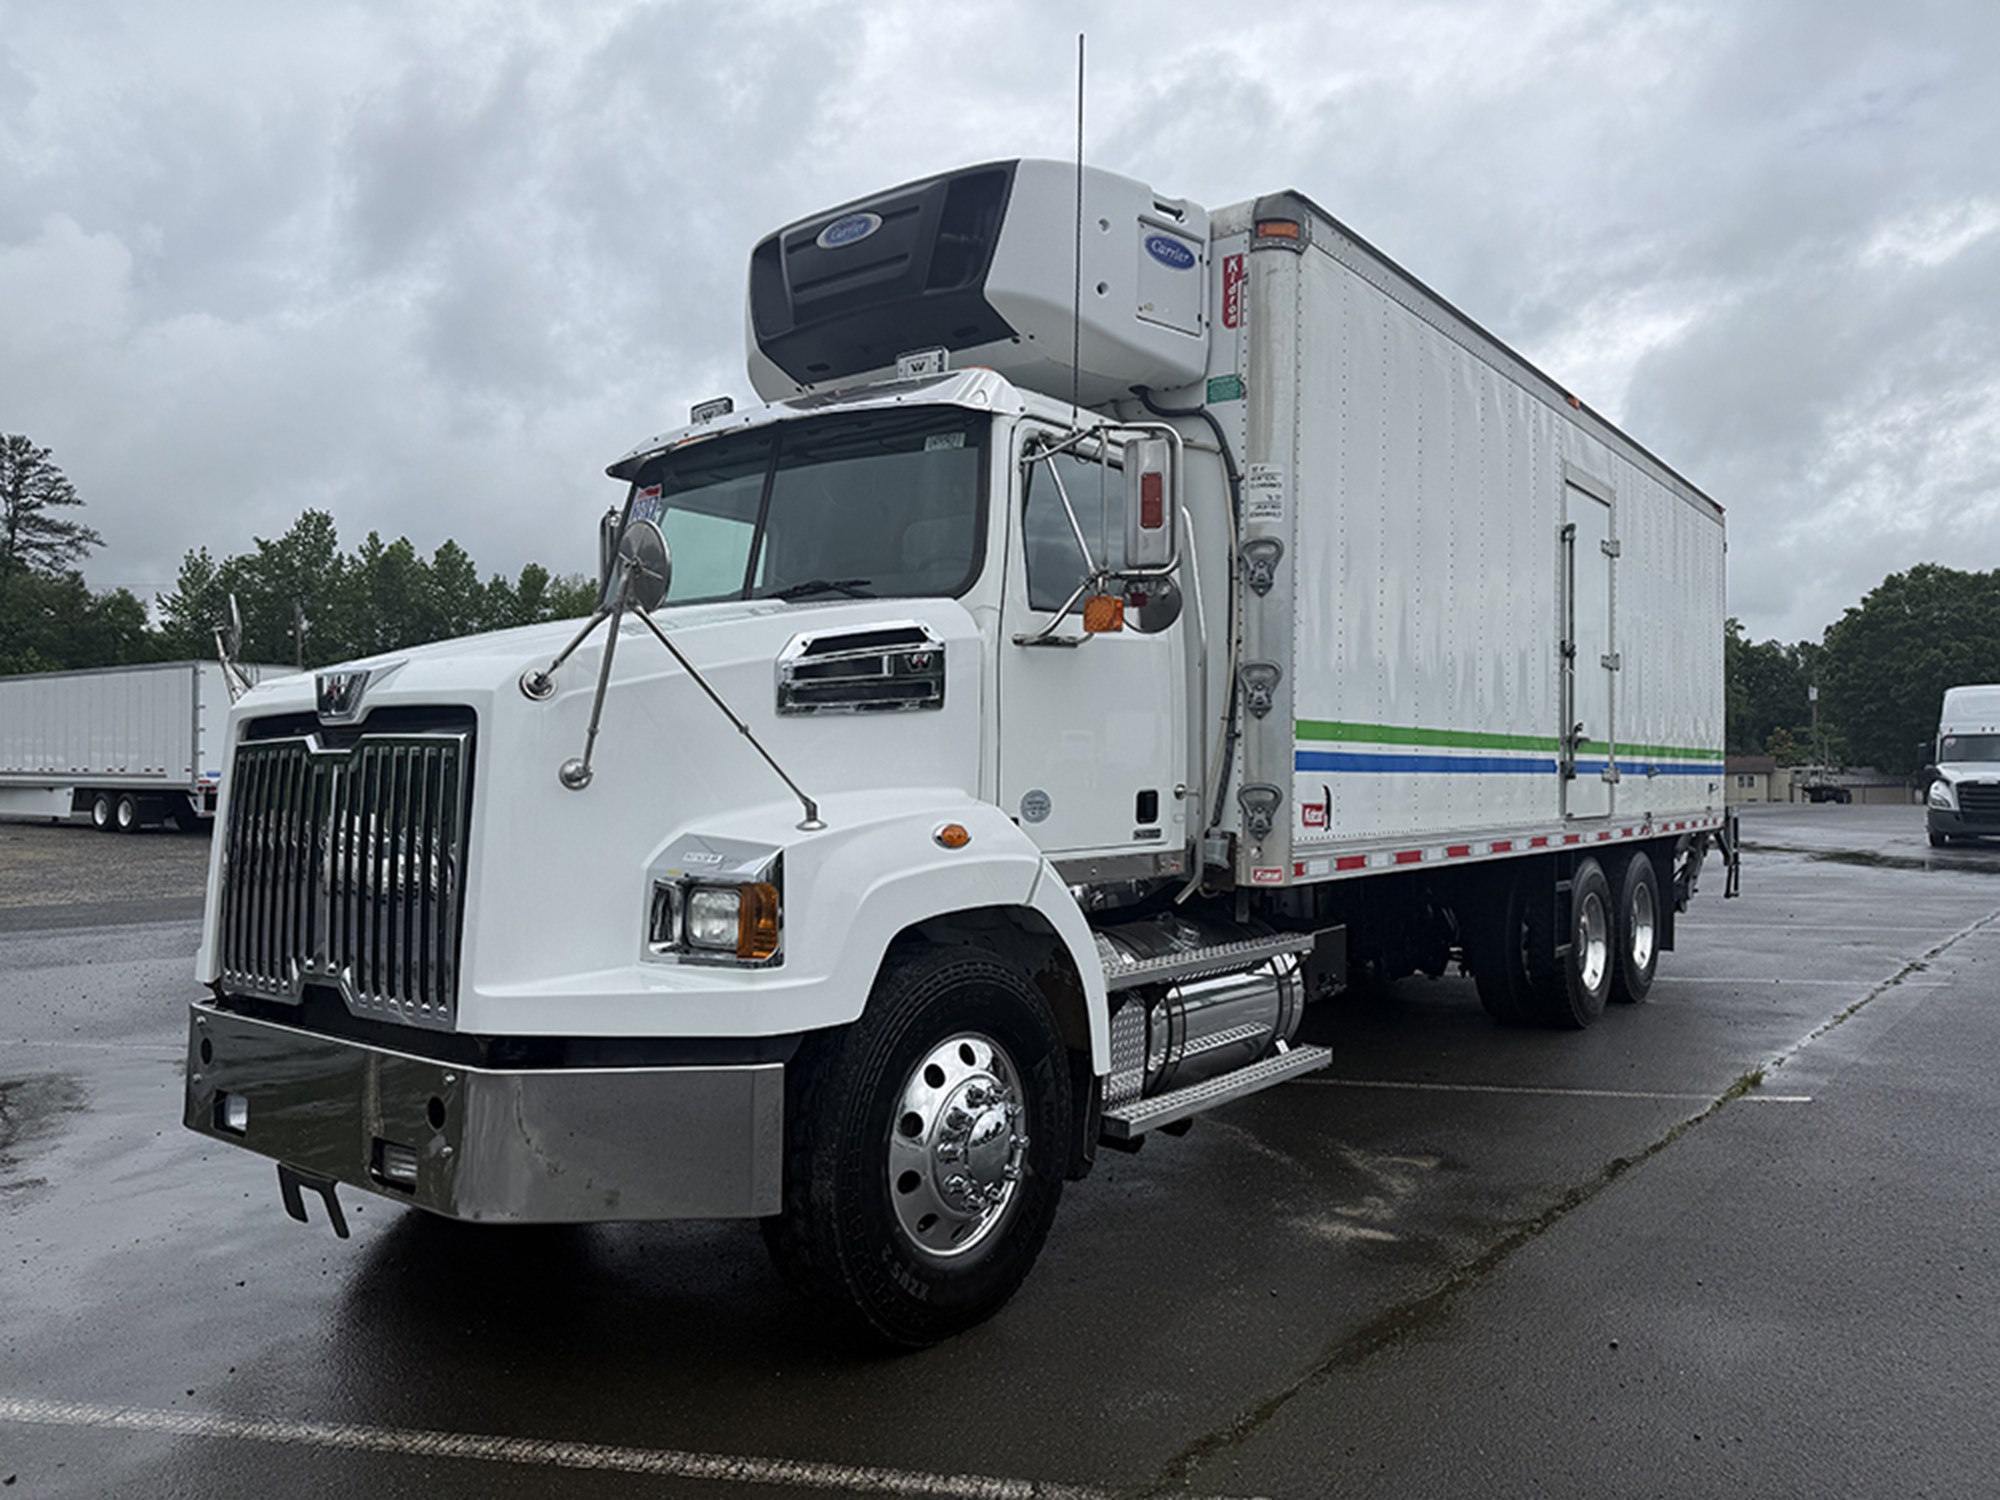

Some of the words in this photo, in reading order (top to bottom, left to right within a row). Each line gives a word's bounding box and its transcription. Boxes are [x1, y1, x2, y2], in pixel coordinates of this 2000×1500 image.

[829, 220, 867, 240] Carrier
[1151, 240, 1190, 262] Carrier
[1227, 256, 1239, 325] Kidron
